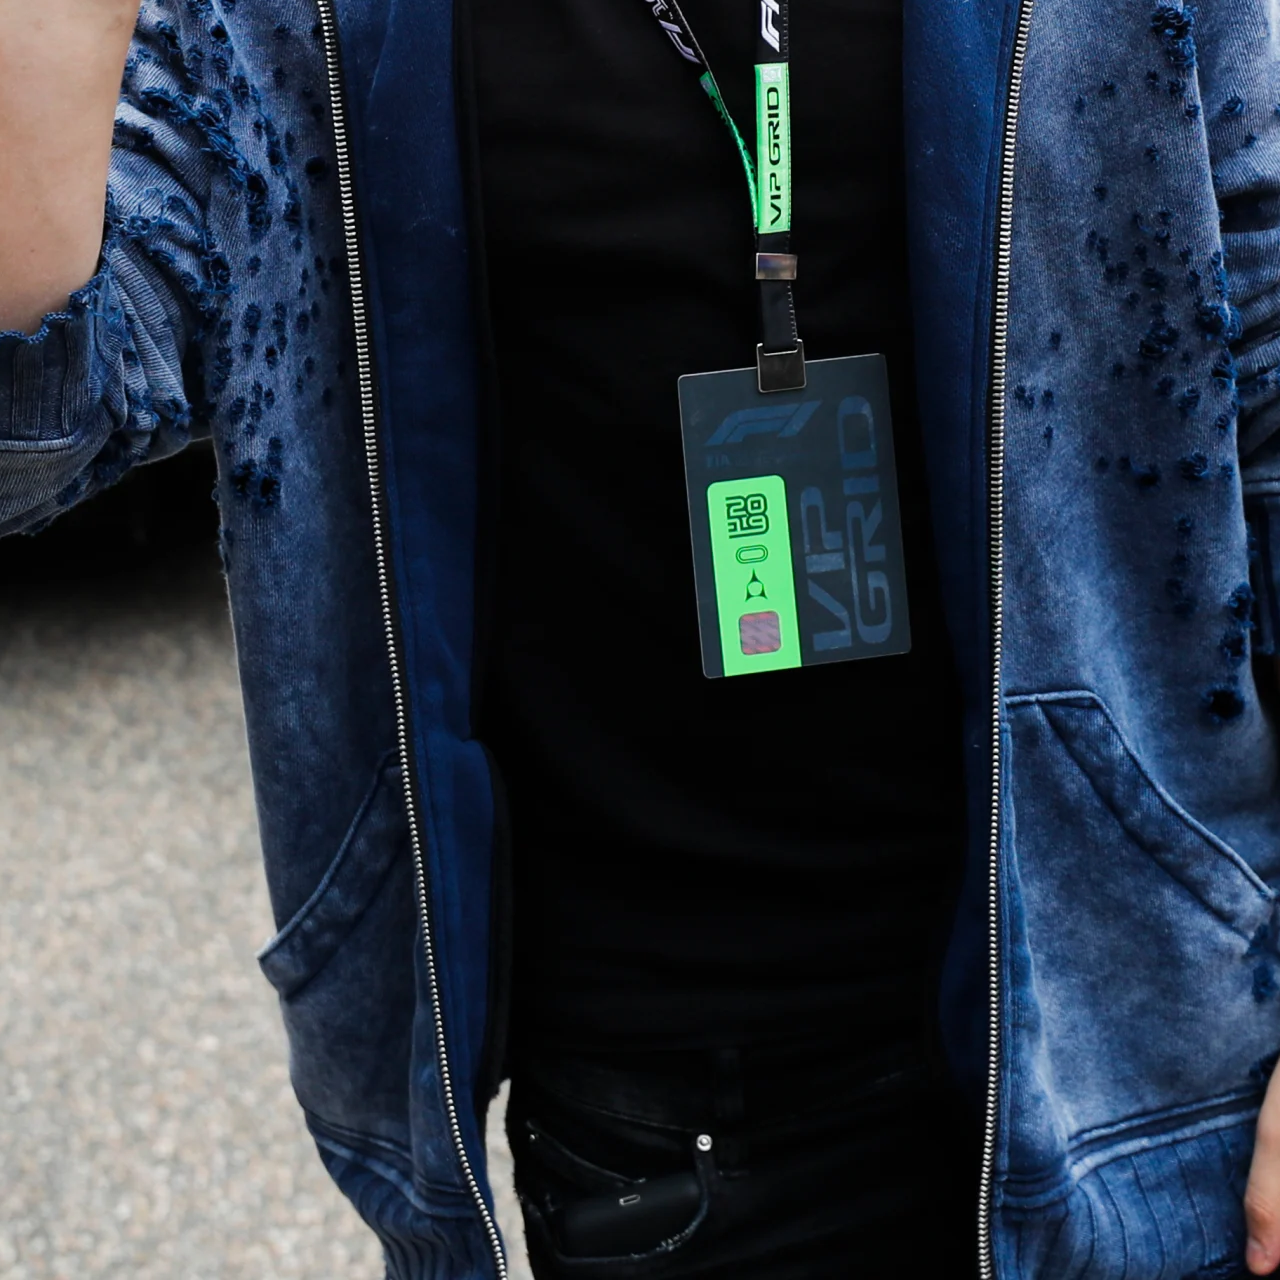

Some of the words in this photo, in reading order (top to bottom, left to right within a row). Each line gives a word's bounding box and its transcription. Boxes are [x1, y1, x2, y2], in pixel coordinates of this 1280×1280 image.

[767, 87, 781, 166] GRID
[770, 172, 782, 226] VIP
[800, 486, 852, 652] VIP
[837, 395, 893, 644] GRID
